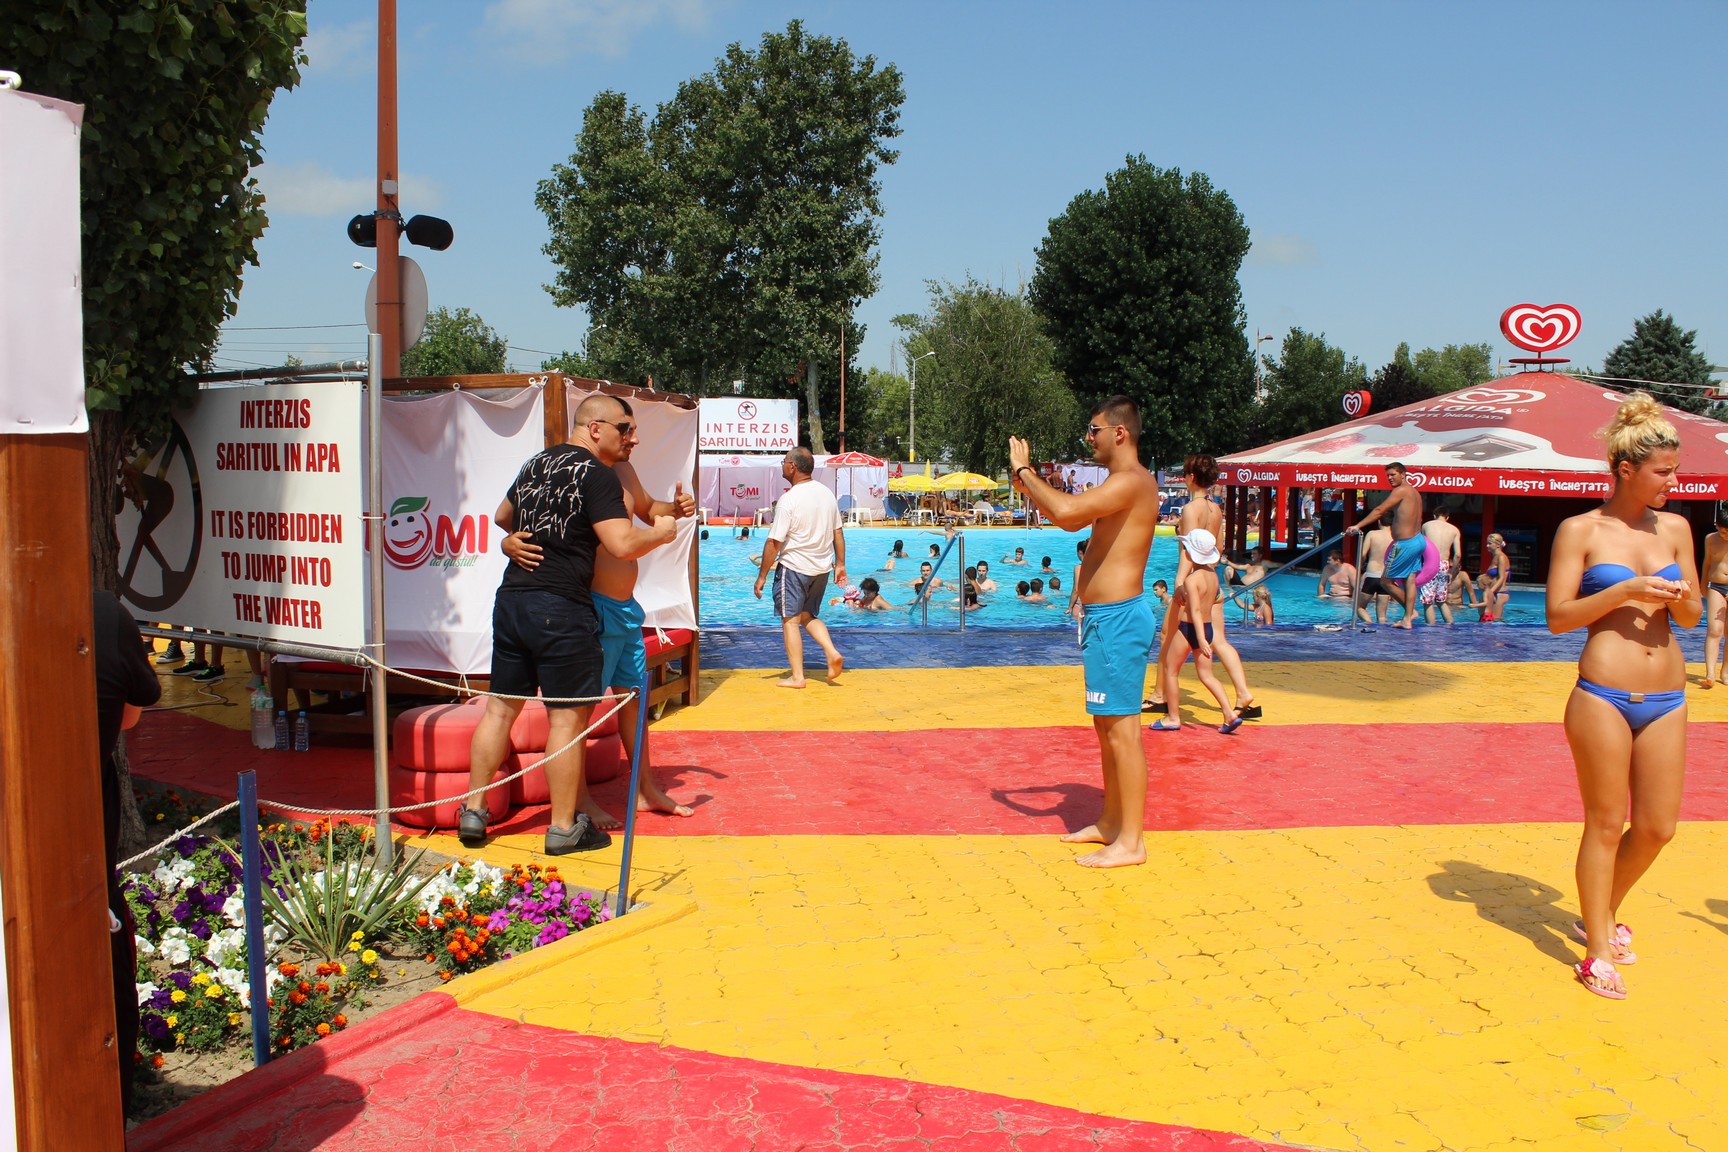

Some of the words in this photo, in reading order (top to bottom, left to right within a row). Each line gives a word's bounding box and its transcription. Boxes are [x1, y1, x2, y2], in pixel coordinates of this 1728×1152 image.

[240, 398, 311, 429] INTERZIS
[1405, 404, 1512, 415] ALGIDA
[706, 422, 789, 434] INTERZIS
[699, 436, 752, 447] SARITUL
[755, 437, 767, 447] IN
[770, 437, 795, 447] APA
[216, 442, 280, 471] SARITUL
[284, 442, 301, 472] IN
[305, 443, 341, 473] APA
[1252, 472, 1280, 481] ALGIDA
[1429, 476, 1474, 487] ALGIDA
[730, 486, 759, 499] TOMI
[211, 510, 225, 538] IT
[229, 510, 244, 539] IS
[248, 511, 342, 543] FORBIDDEN
[221, 552, 241, 580] TO
[245, 553, 287, 583] JUMP
[291, 556, 331, 587] INTO
[233, 593, 262, 623] THE
[265, 597, 322, 629] WATER
